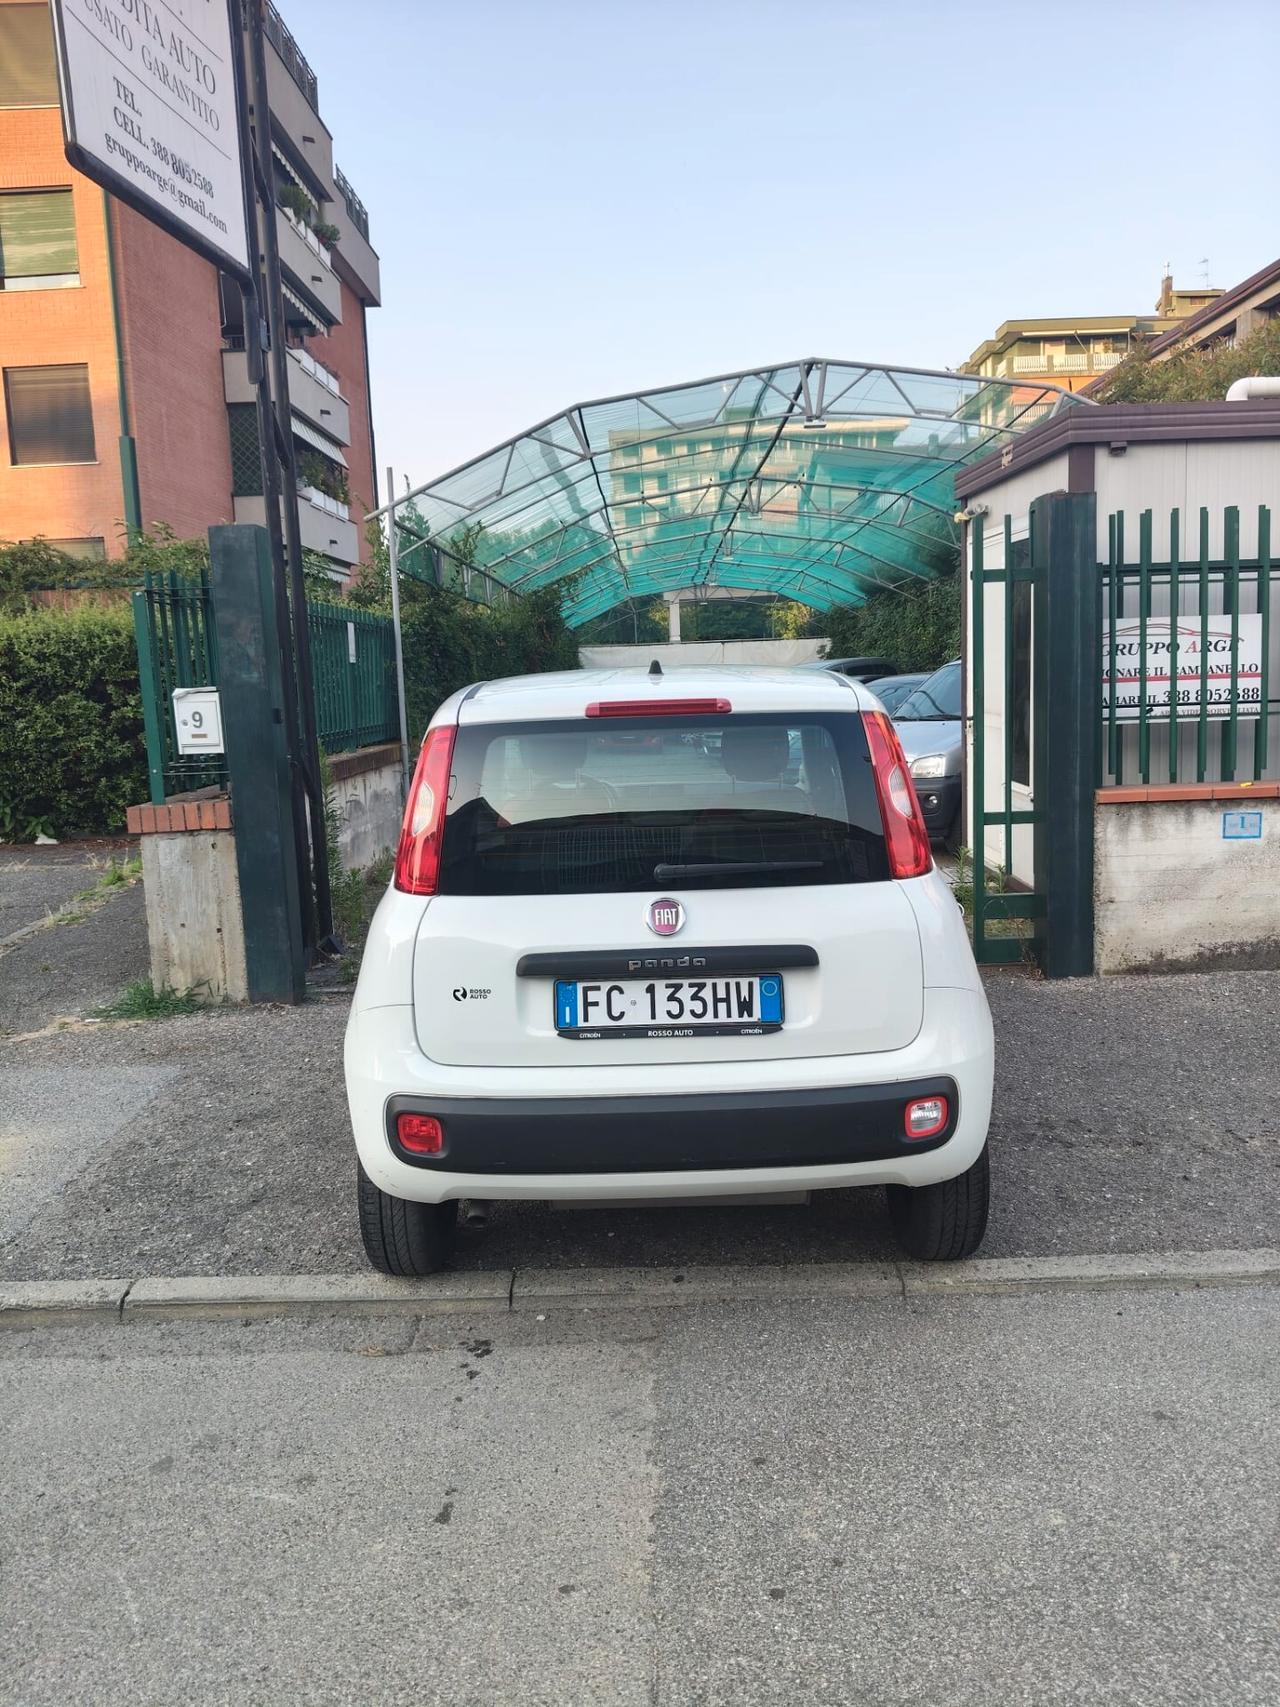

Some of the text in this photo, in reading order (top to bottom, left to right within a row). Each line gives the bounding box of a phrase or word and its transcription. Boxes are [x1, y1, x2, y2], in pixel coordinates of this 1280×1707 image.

[169, 32, 216, 94] AUTO
[112, 76, 143, 117] TEL.
[141, 45, 220, 132] GARANTITO
[113, 105, 149, 151] CELL.
[149, 137, 169, 168] 388
[104, 132, 228, 234] gruppoarge@gmail.com
[1154, 666, 1167, 676] IL
[1176, 663, 1259, 675] AMANELO
[192, 711, 203, 729] 9
[655, 907, 677, 925] FIAT
[628, 956, 707, 971] panda
[582, 981, 754, 1024] FC 133HW
[647, 1029, 673, 1037] ROSSO
